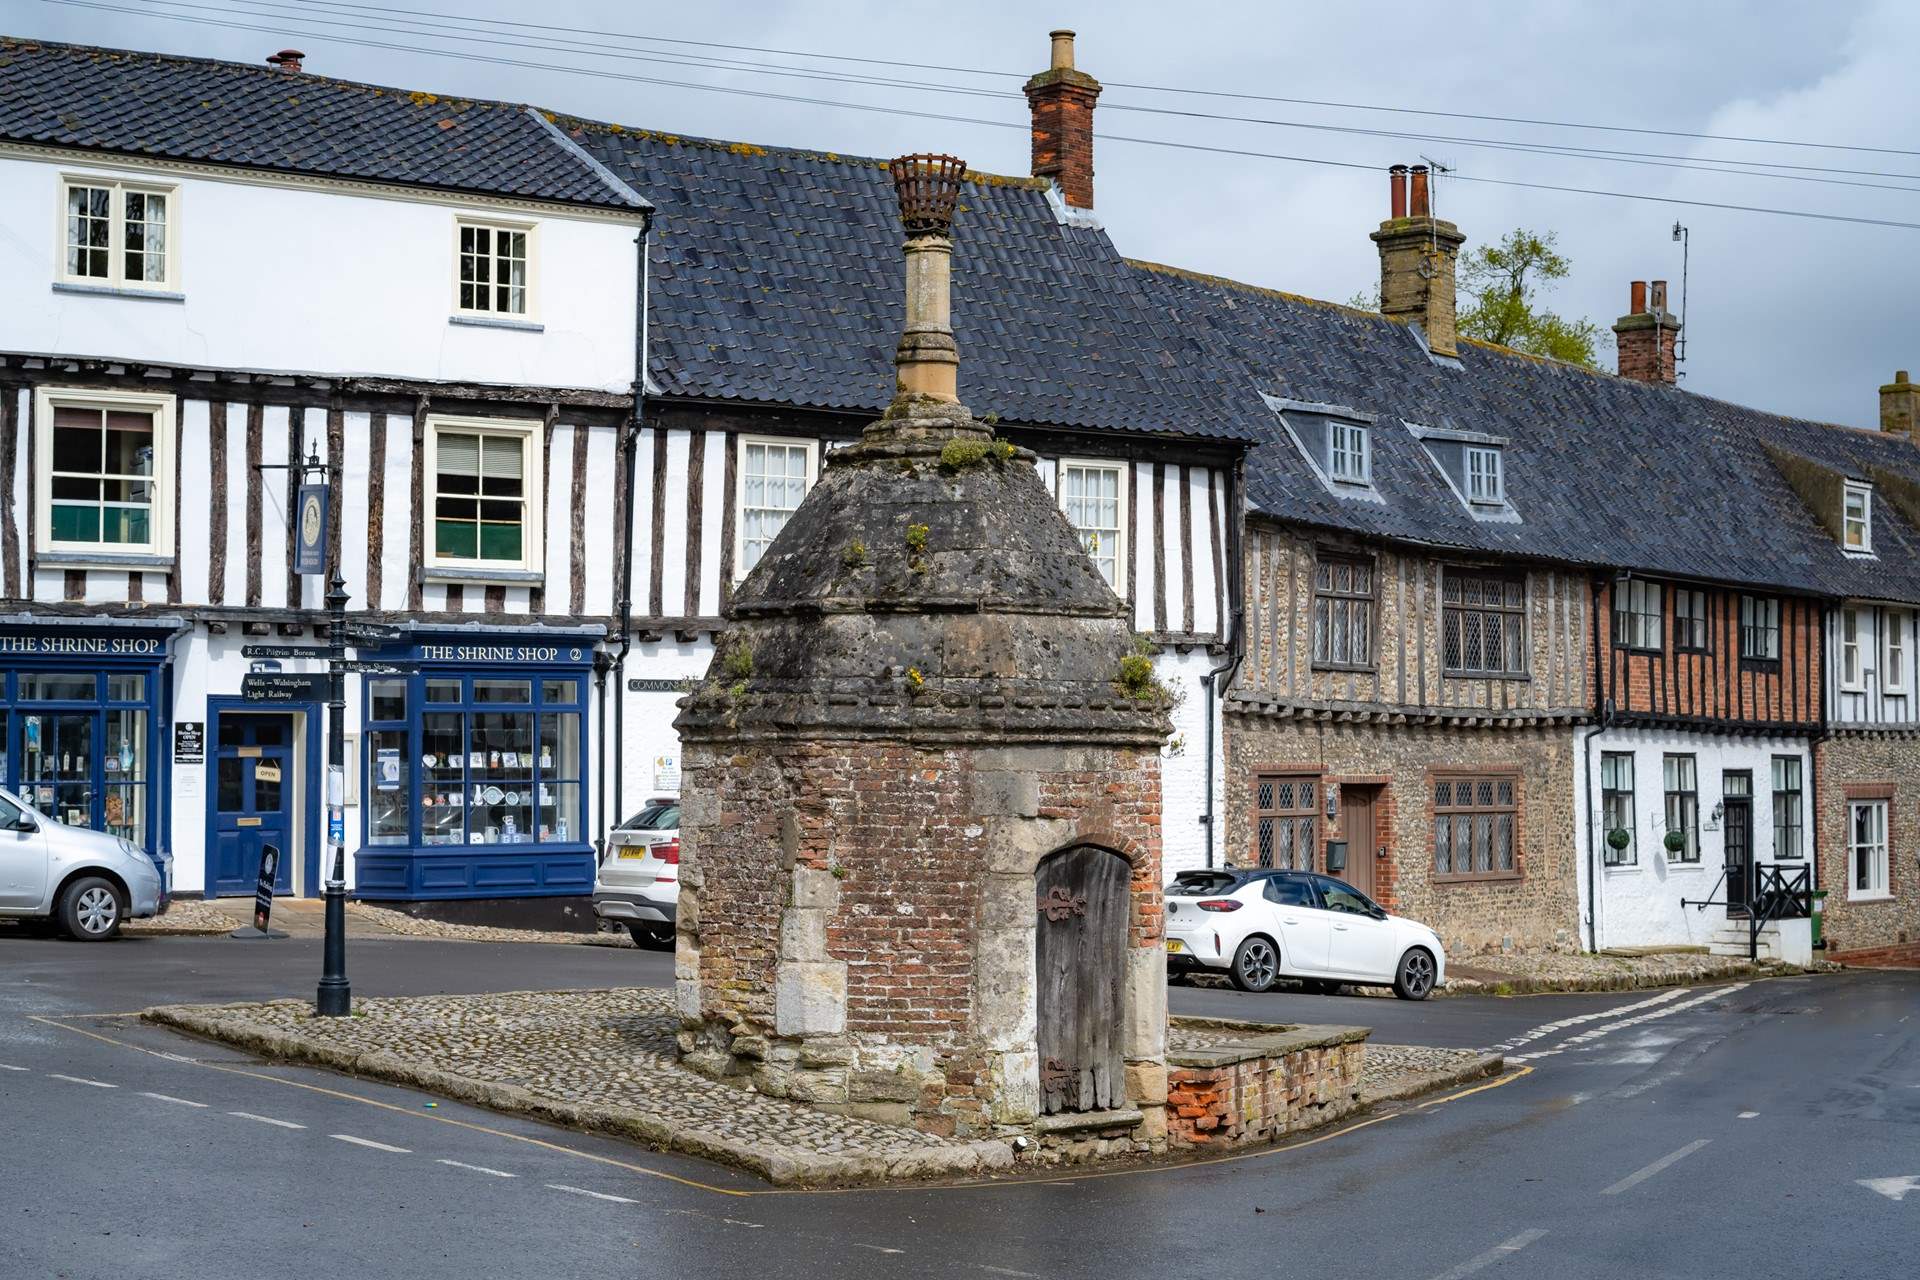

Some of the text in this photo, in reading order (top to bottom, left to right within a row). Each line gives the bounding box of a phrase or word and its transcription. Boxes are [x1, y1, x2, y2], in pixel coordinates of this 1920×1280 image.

[0, 637, 159, 653] THE SHRINE SHOP
[247, 648, 264, 656] R.C.
[266, 648, 290, 657] Pilgrim
[421, 645, 453, 659] THE
[457, 647, 513, 661] SHRINE
[517, 648, 558, 661] SHOP
[247, 678, 265, 686] Wells
[273, 678, 312, 688] Walsingham
[247, 690, 293, 700] Light Railway
